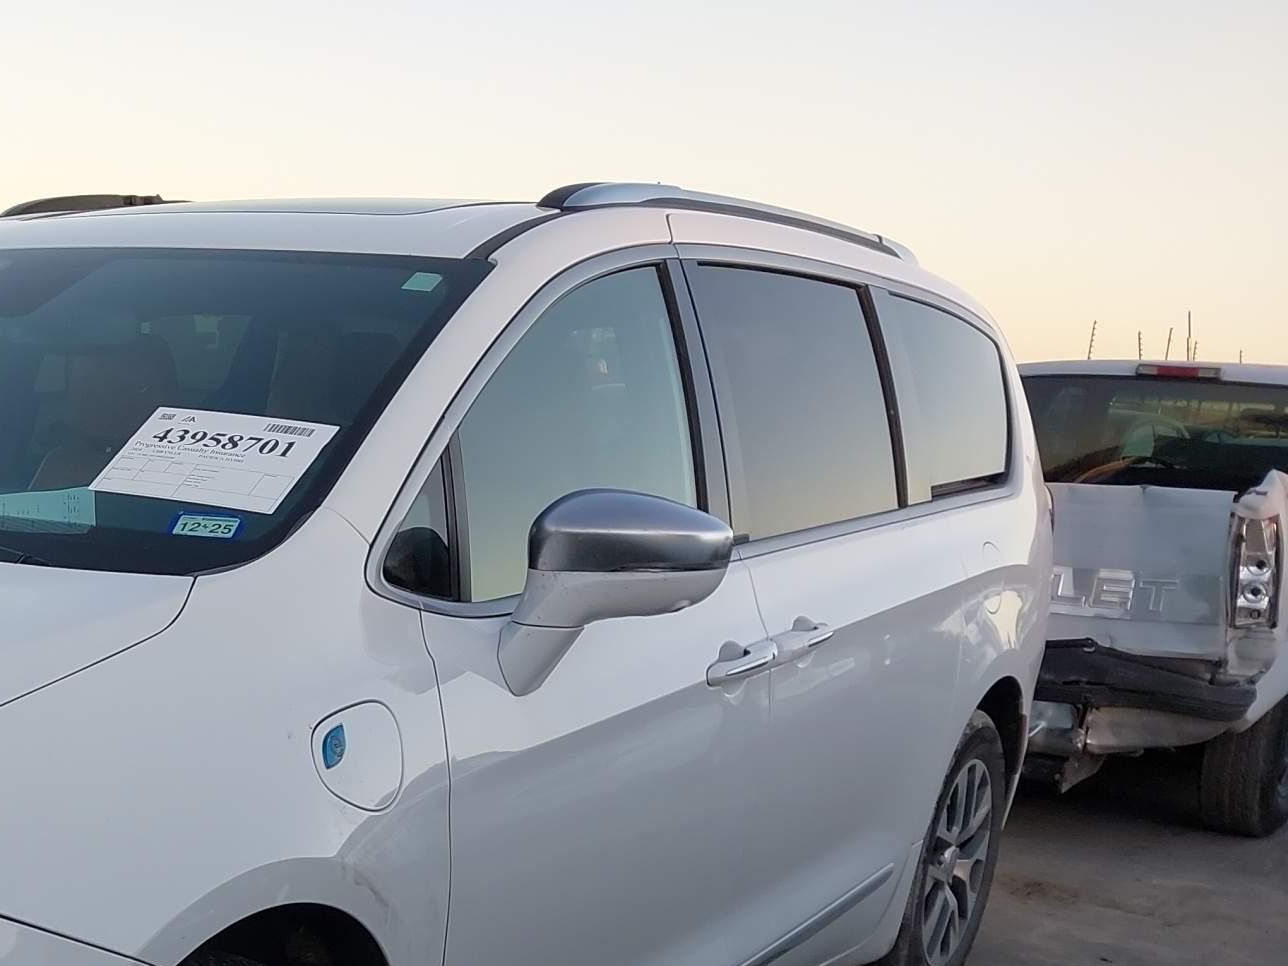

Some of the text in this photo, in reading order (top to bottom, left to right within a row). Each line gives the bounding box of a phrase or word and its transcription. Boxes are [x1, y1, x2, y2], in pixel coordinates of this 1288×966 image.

[135, 440, 177, 452] Progressive
[210, 448, 246, 458] Insurance
[152, 427, 297, 458] 43958701
